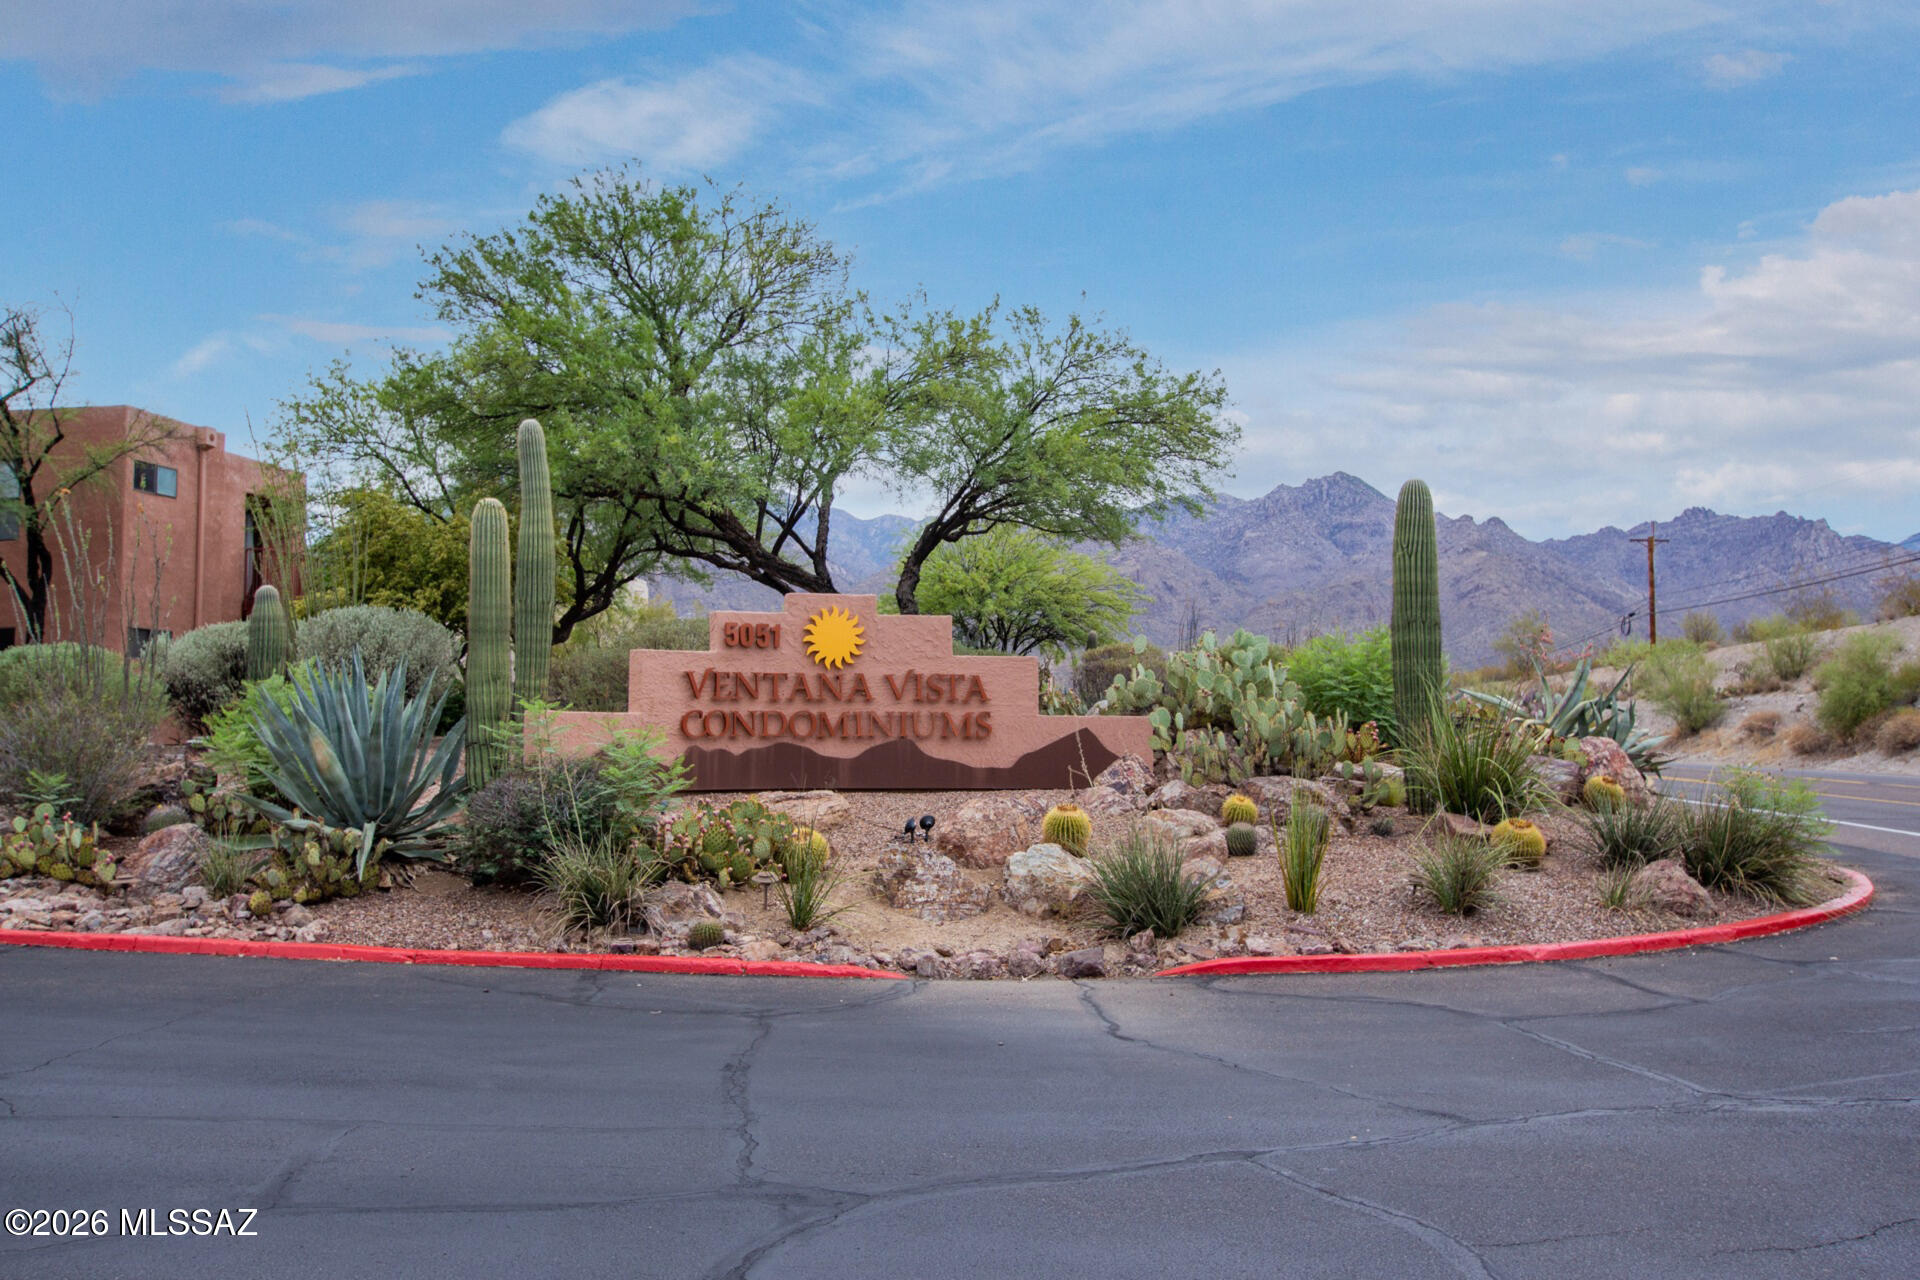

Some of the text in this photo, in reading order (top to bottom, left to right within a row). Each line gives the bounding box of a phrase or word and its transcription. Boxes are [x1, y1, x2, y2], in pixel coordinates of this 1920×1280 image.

[724, 622, 781, 649] 5051
[685, 667, 992, 703] VENTANA VISTA
[680, 710, 993, 739] CONDOMINIUMS
